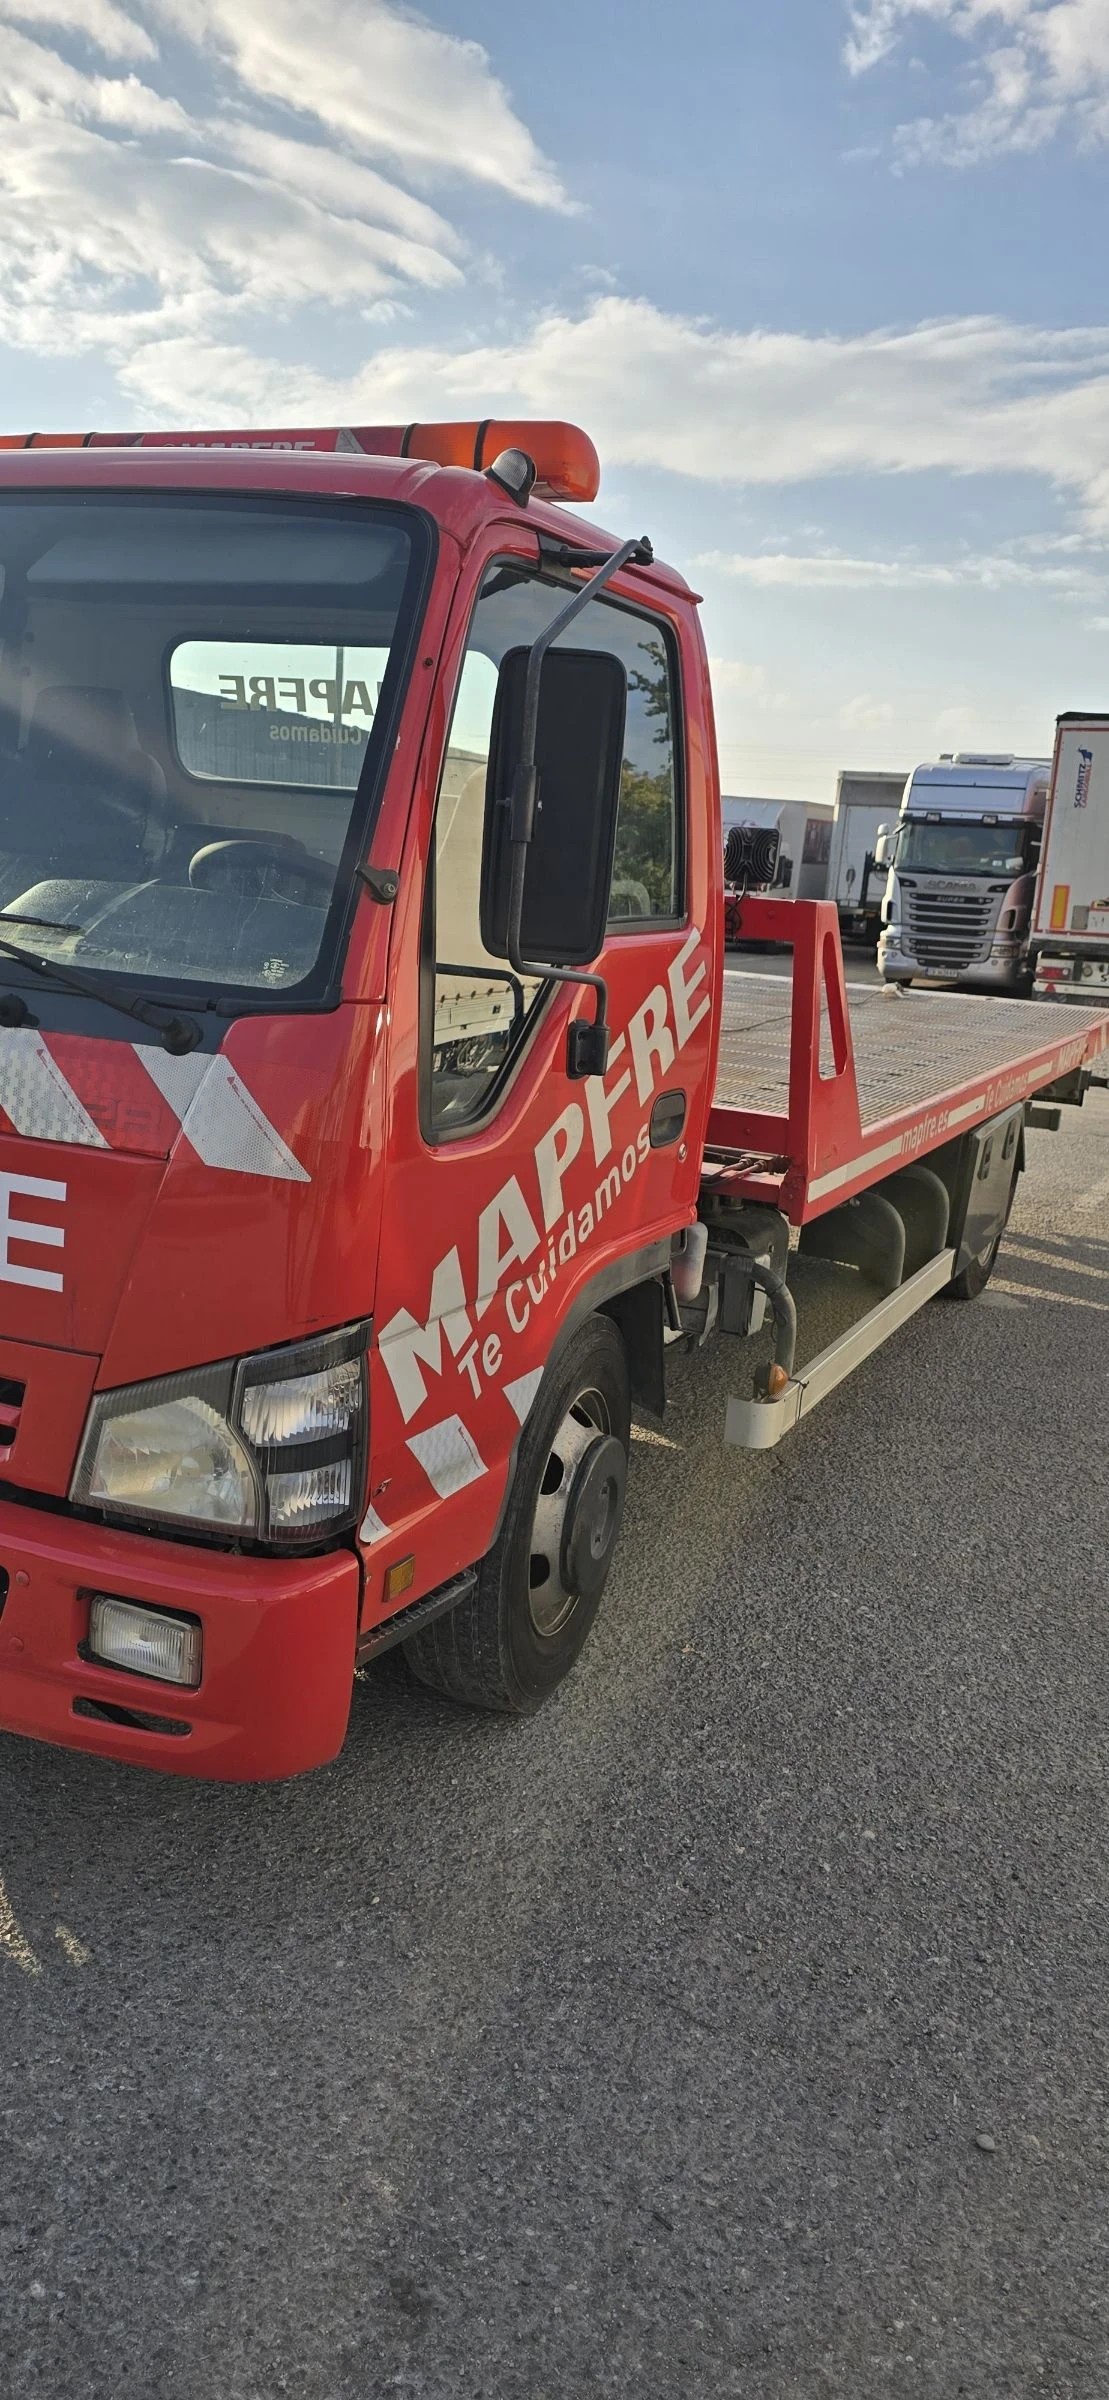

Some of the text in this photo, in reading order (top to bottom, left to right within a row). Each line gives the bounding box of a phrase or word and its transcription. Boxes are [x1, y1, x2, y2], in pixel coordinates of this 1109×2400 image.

[379, 927, 711, 1425] MAPFRE
[457, 1121, 650, 1400] Te Cuidamos
